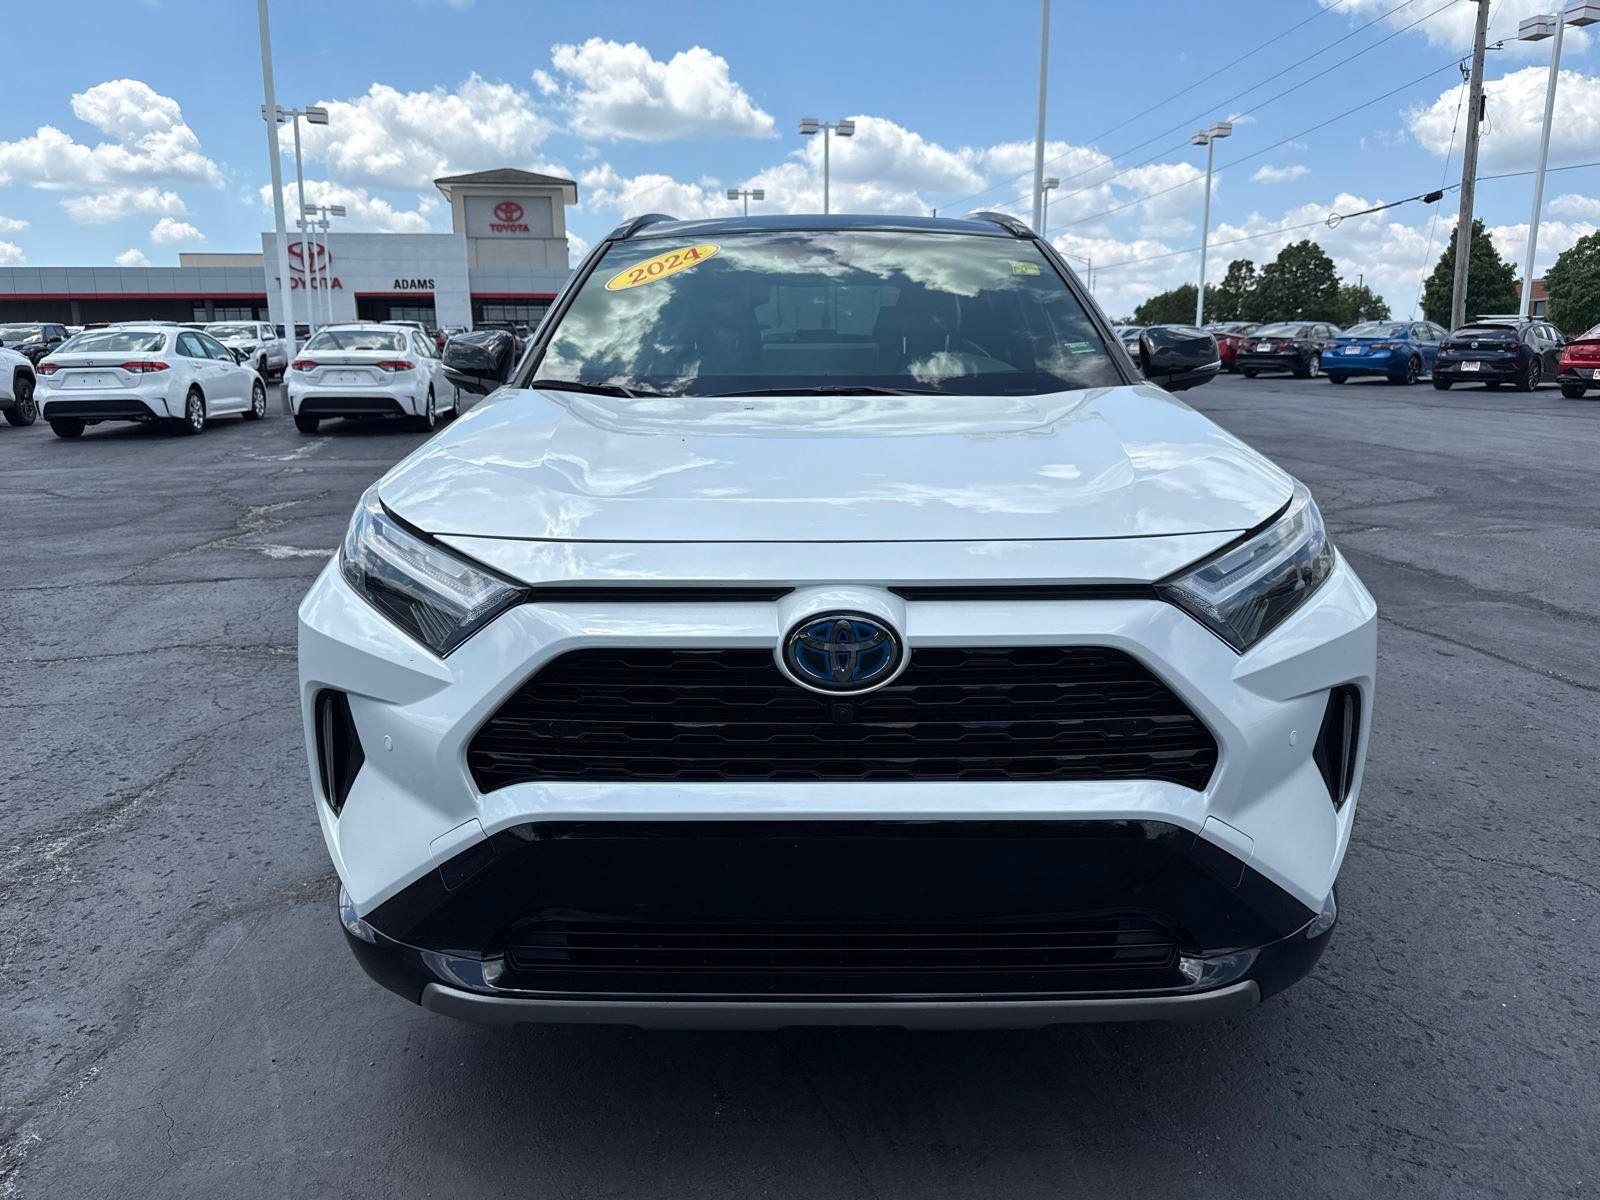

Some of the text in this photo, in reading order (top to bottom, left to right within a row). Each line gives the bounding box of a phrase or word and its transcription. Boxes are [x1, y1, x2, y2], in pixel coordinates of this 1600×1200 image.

[489, 224, 530, 232] TOYOTA
[627, 247, 703, 285] 2024
[393, 279, 435, 290] ADAMS
